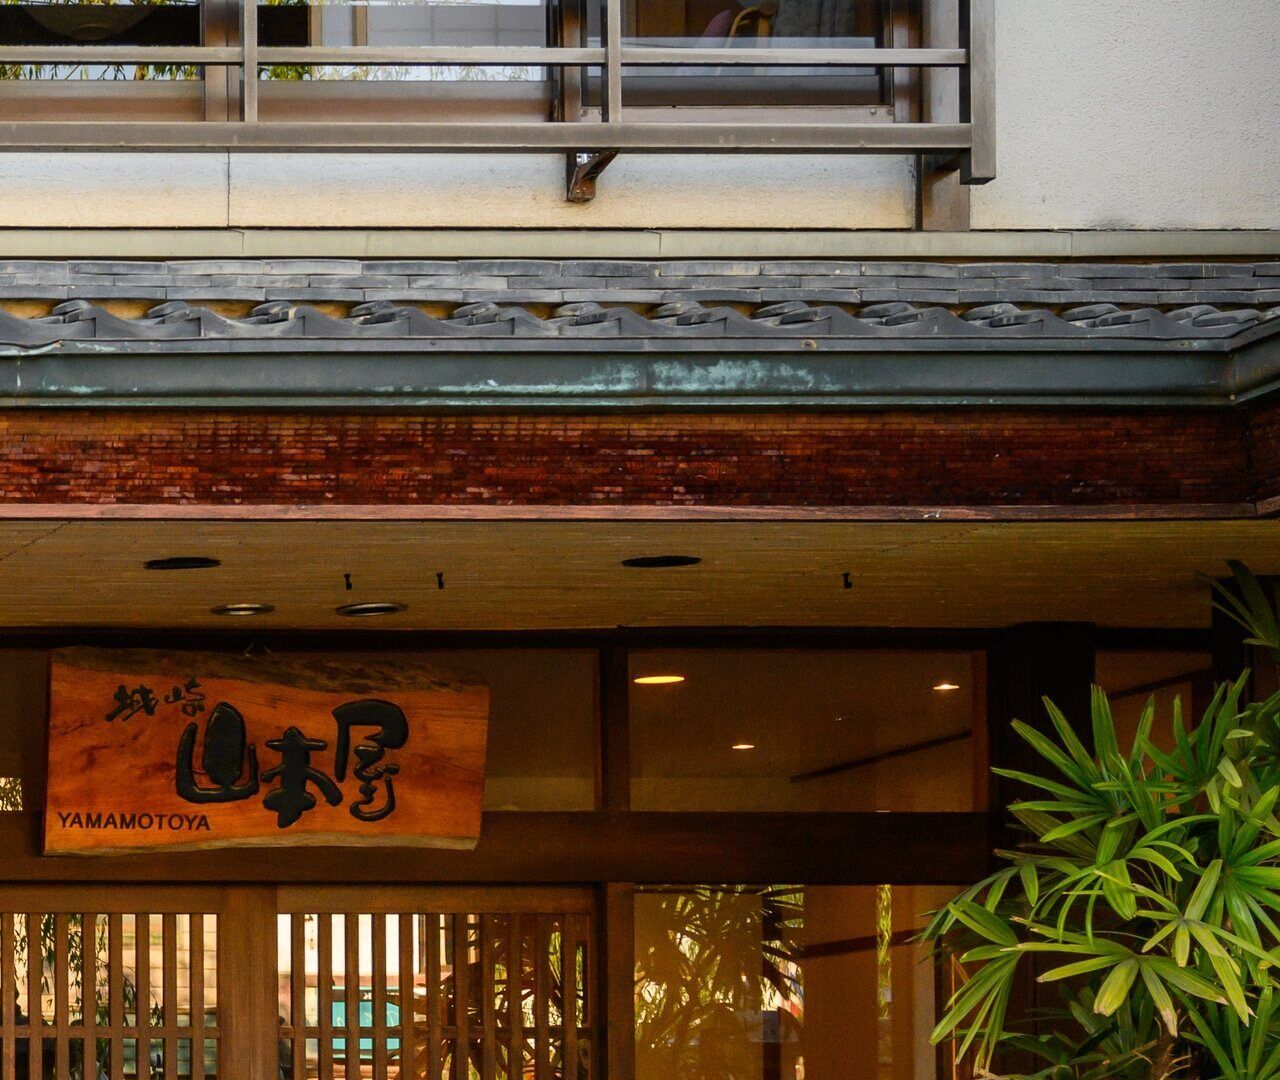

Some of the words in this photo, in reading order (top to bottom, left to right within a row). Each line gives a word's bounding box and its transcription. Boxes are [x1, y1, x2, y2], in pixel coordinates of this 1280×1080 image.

[174, 698, 411, 829] 山本屋
[57, 811, 211, 832] YAMAMOTOYA
